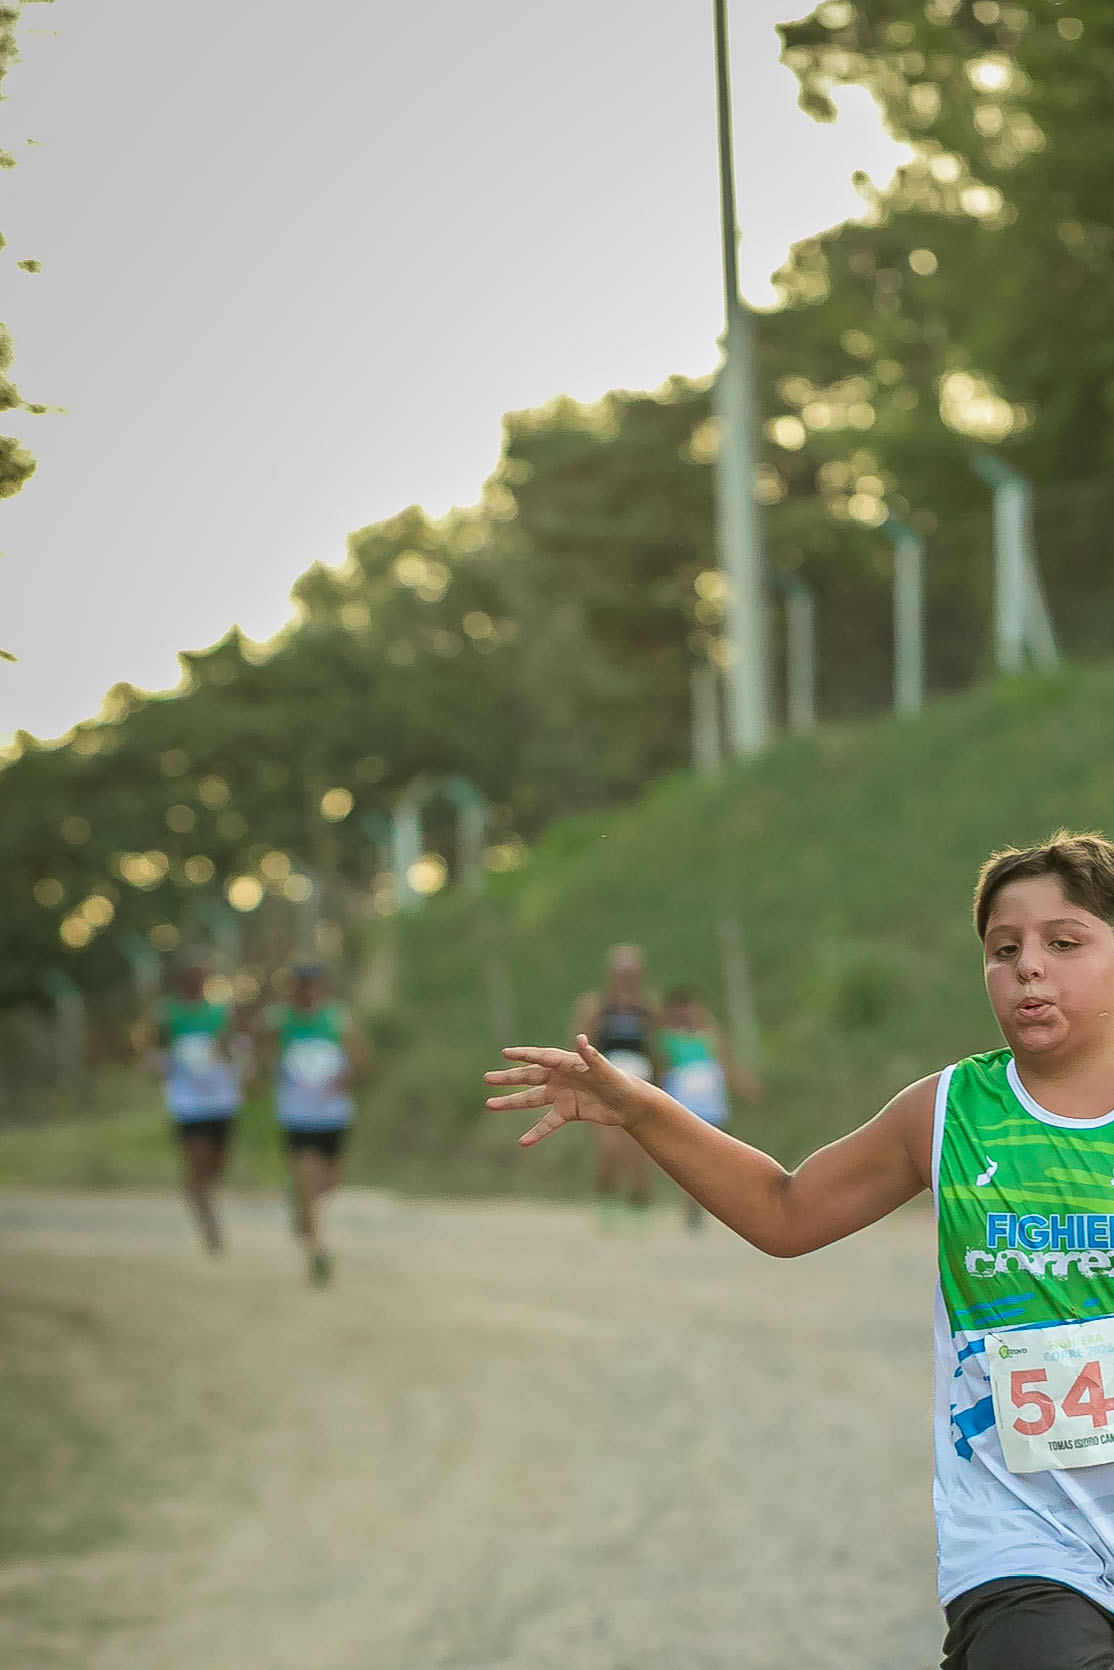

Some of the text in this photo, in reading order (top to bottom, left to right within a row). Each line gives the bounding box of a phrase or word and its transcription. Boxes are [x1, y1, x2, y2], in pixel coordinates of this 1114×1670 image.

[1048, 1333, 1104, 1350] FIGHIERA
[1043, 1343, 1114, 1361] CORRE 2026
[1048, 1440, 1073, 1451] TOMAS
[1074, 1436, 1099, 1448] ISIDRO
